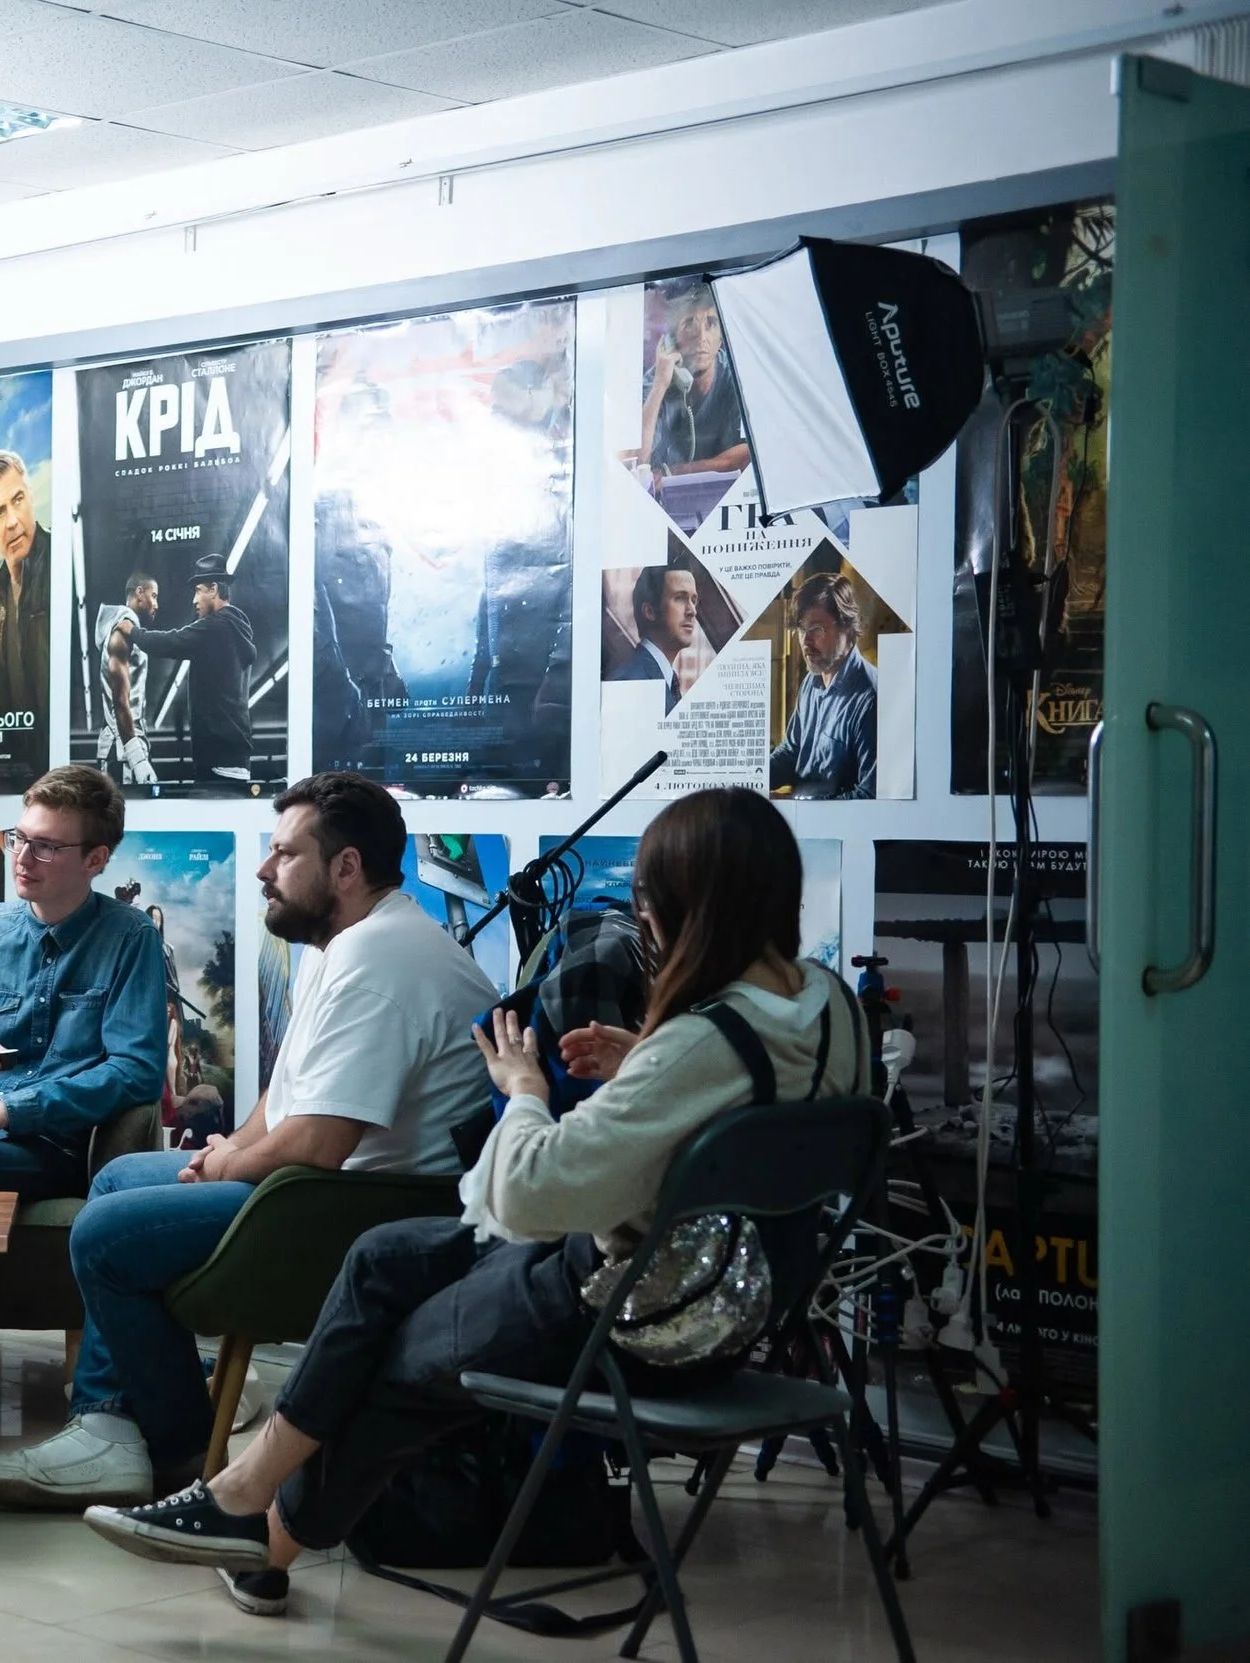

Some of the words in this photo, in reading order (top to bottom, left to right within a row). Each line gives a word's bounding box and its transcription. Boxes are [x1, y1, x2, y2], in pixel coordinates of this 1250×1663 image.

[865, 311, 882, 346] LIGHT
[877, 352, 890, 378] BOX
[877, 301, 920, 409] Aputure
[191, 363, 236, 377] СТАЛЛОНЕ
[122, 374, 163, 389] ДЖОРДАН
[115, 377, 240, 461] КРІД
[115, 467, 153, 477] СПАДОК
[159, 463, 188, 471] РОККІ
[194, 457, 240, 467] БАЛЬБОА
[151, 529, 163, 542] 14
[165, 526, 201, 541] СІЧНЯ
[746, 530, 767, 540] НА
[702, 538, 812, 555] ПОНИЖЕННЯ
[725, 565, 734, 573] ЦЕ
[734, 564, 757, 572] ВАЖКО
[367, 698, 410, 708] БЕТМЕН
[442, 695, 511, 706] СУПЕРМЕНА
[405, 753, 418, 763] 24
[422, 752, 469, 763] БЕРЕЗНЯ
[654, 782, 660, 790] 4
[1031, 849, 1069, 859] ІРОЮ
[968, 860, 1008, 869] ТАКЮ
